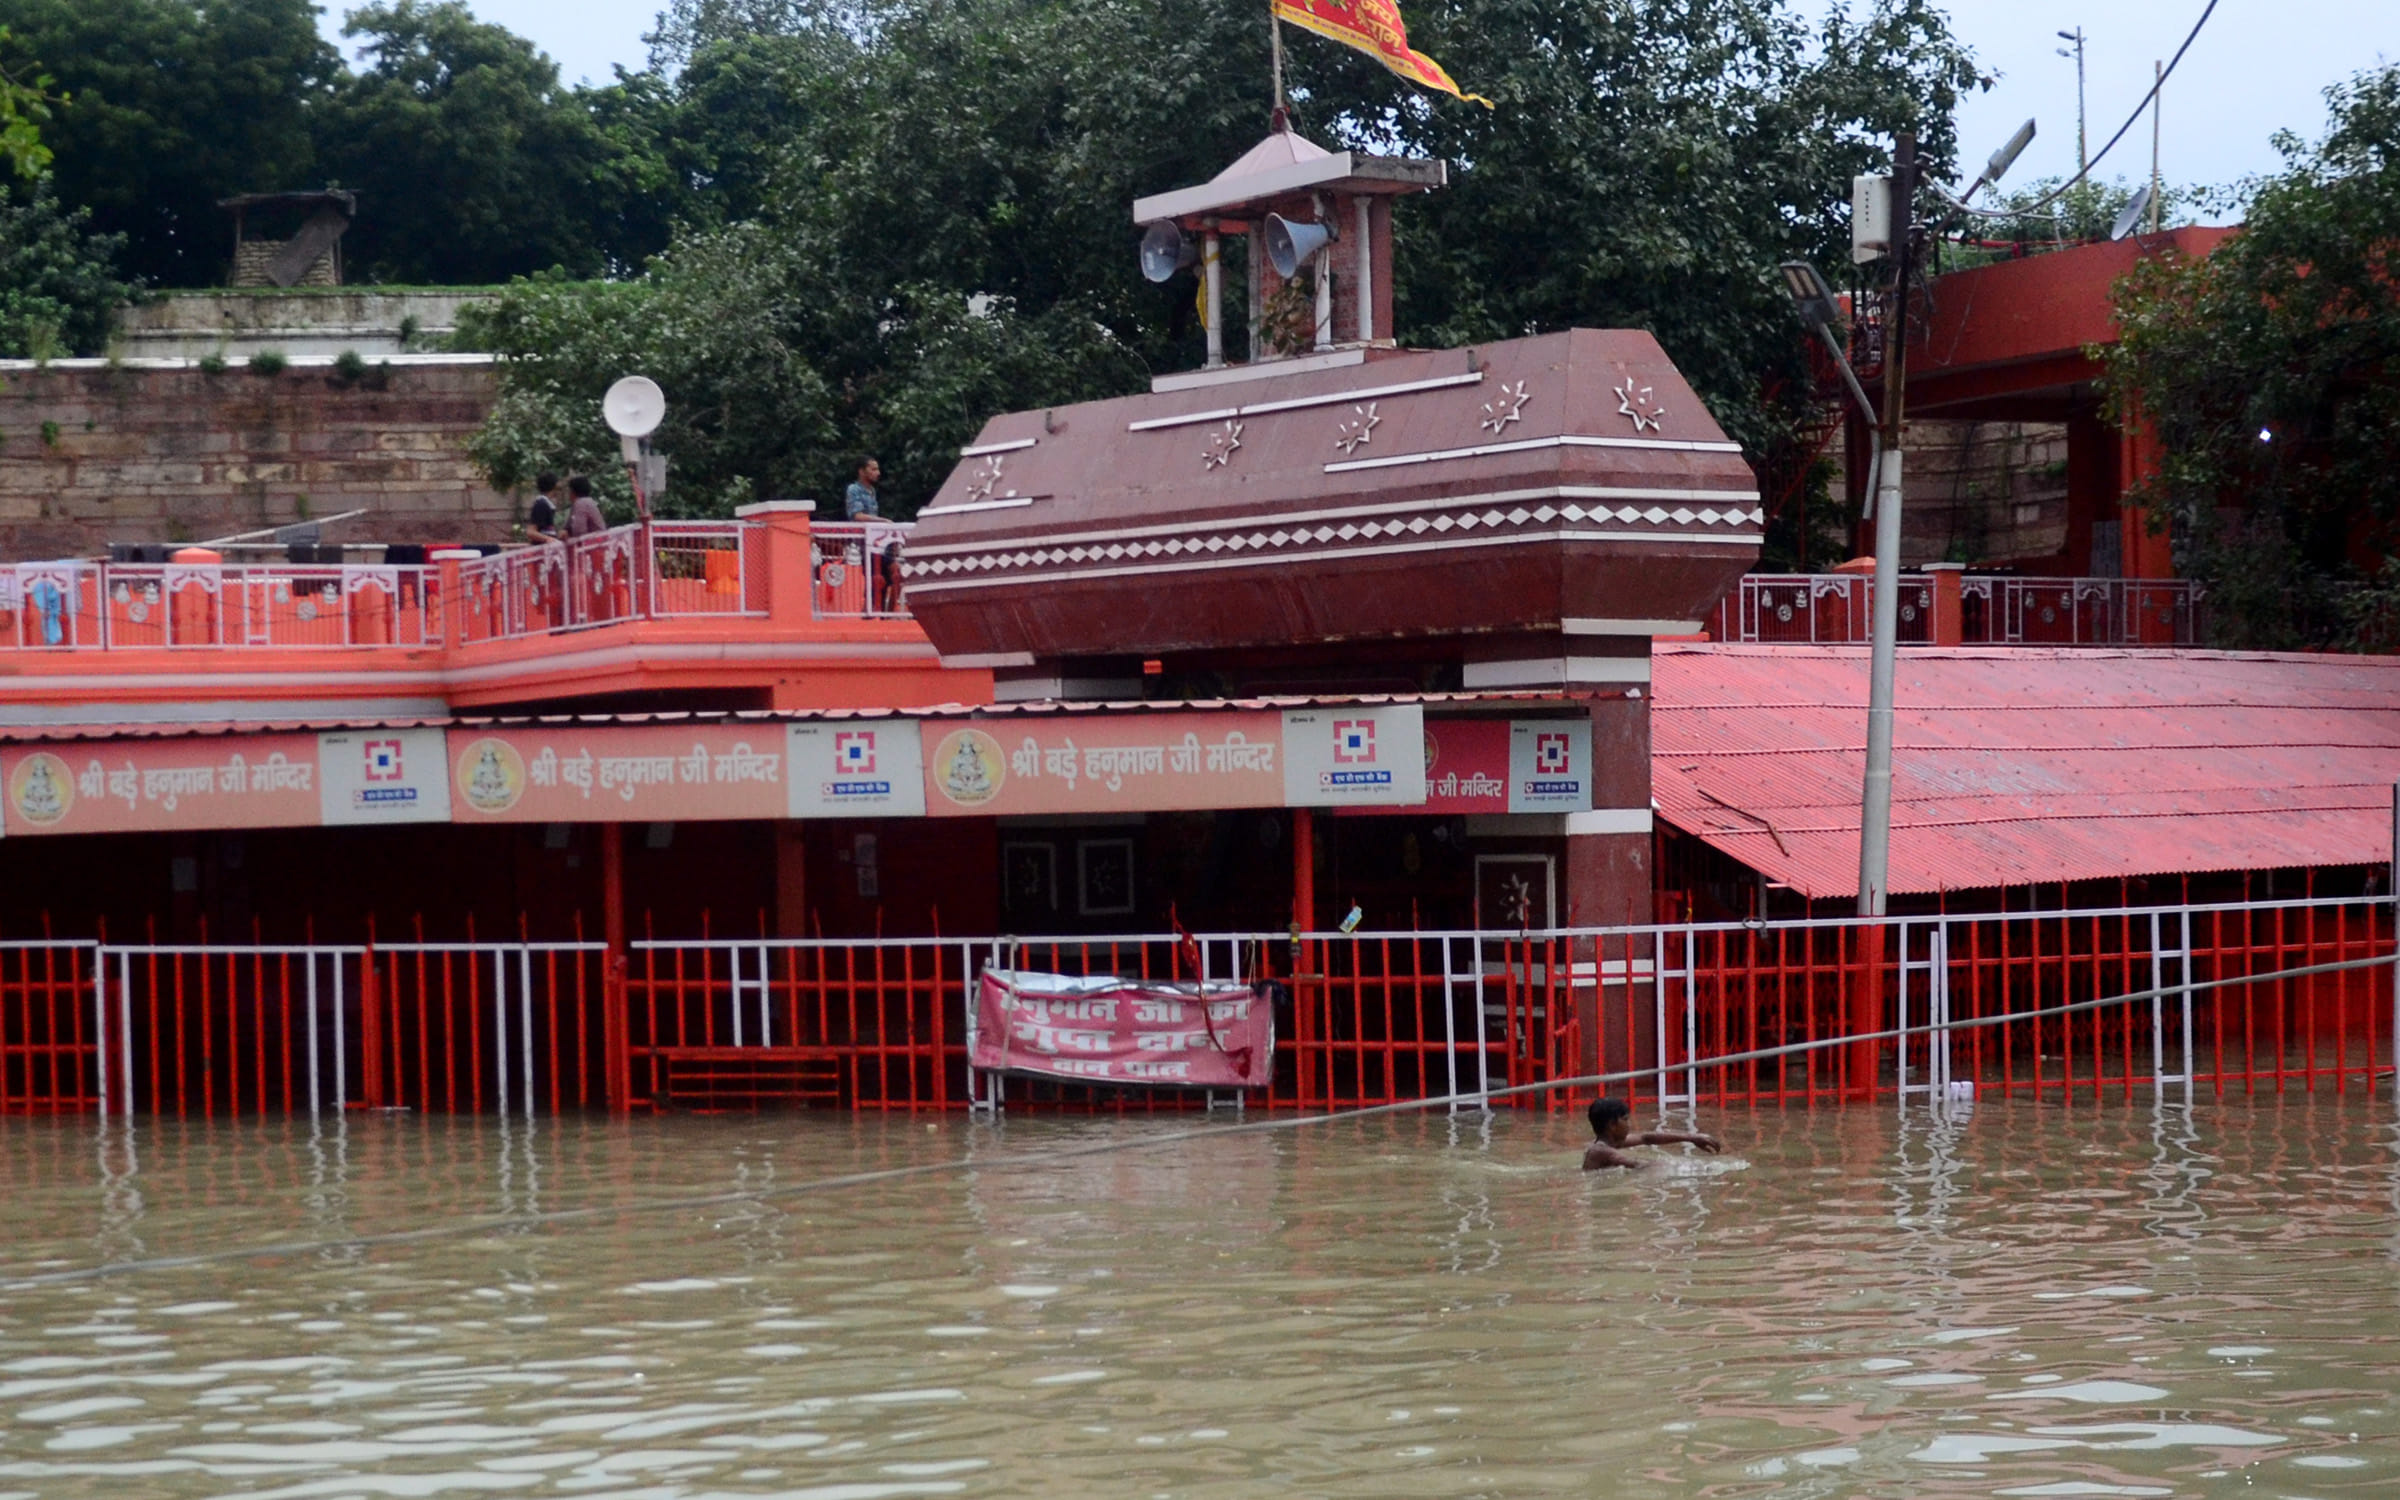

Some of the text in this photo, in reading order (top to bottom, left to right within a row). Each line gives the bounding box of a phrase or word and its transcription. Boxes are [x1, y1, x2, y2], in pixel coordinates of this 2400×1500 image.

[80, 751, 313, 812] श्री बड़े हनुमान जी मन्दिर
[531, 741, 780, 801] श्री बड़े हनुमान जी मन्दिर
[1012, 731, 1276, 792] श्री बड़े हनुमान जी मन्दिर
[1437, 772, 1457, 797] जी
[1460, 771, 1504, 797] मन्दिर
[1131, 998, 1186, 1023] जी
[1013, 1021, 1231, 1054] गुप्त दान
